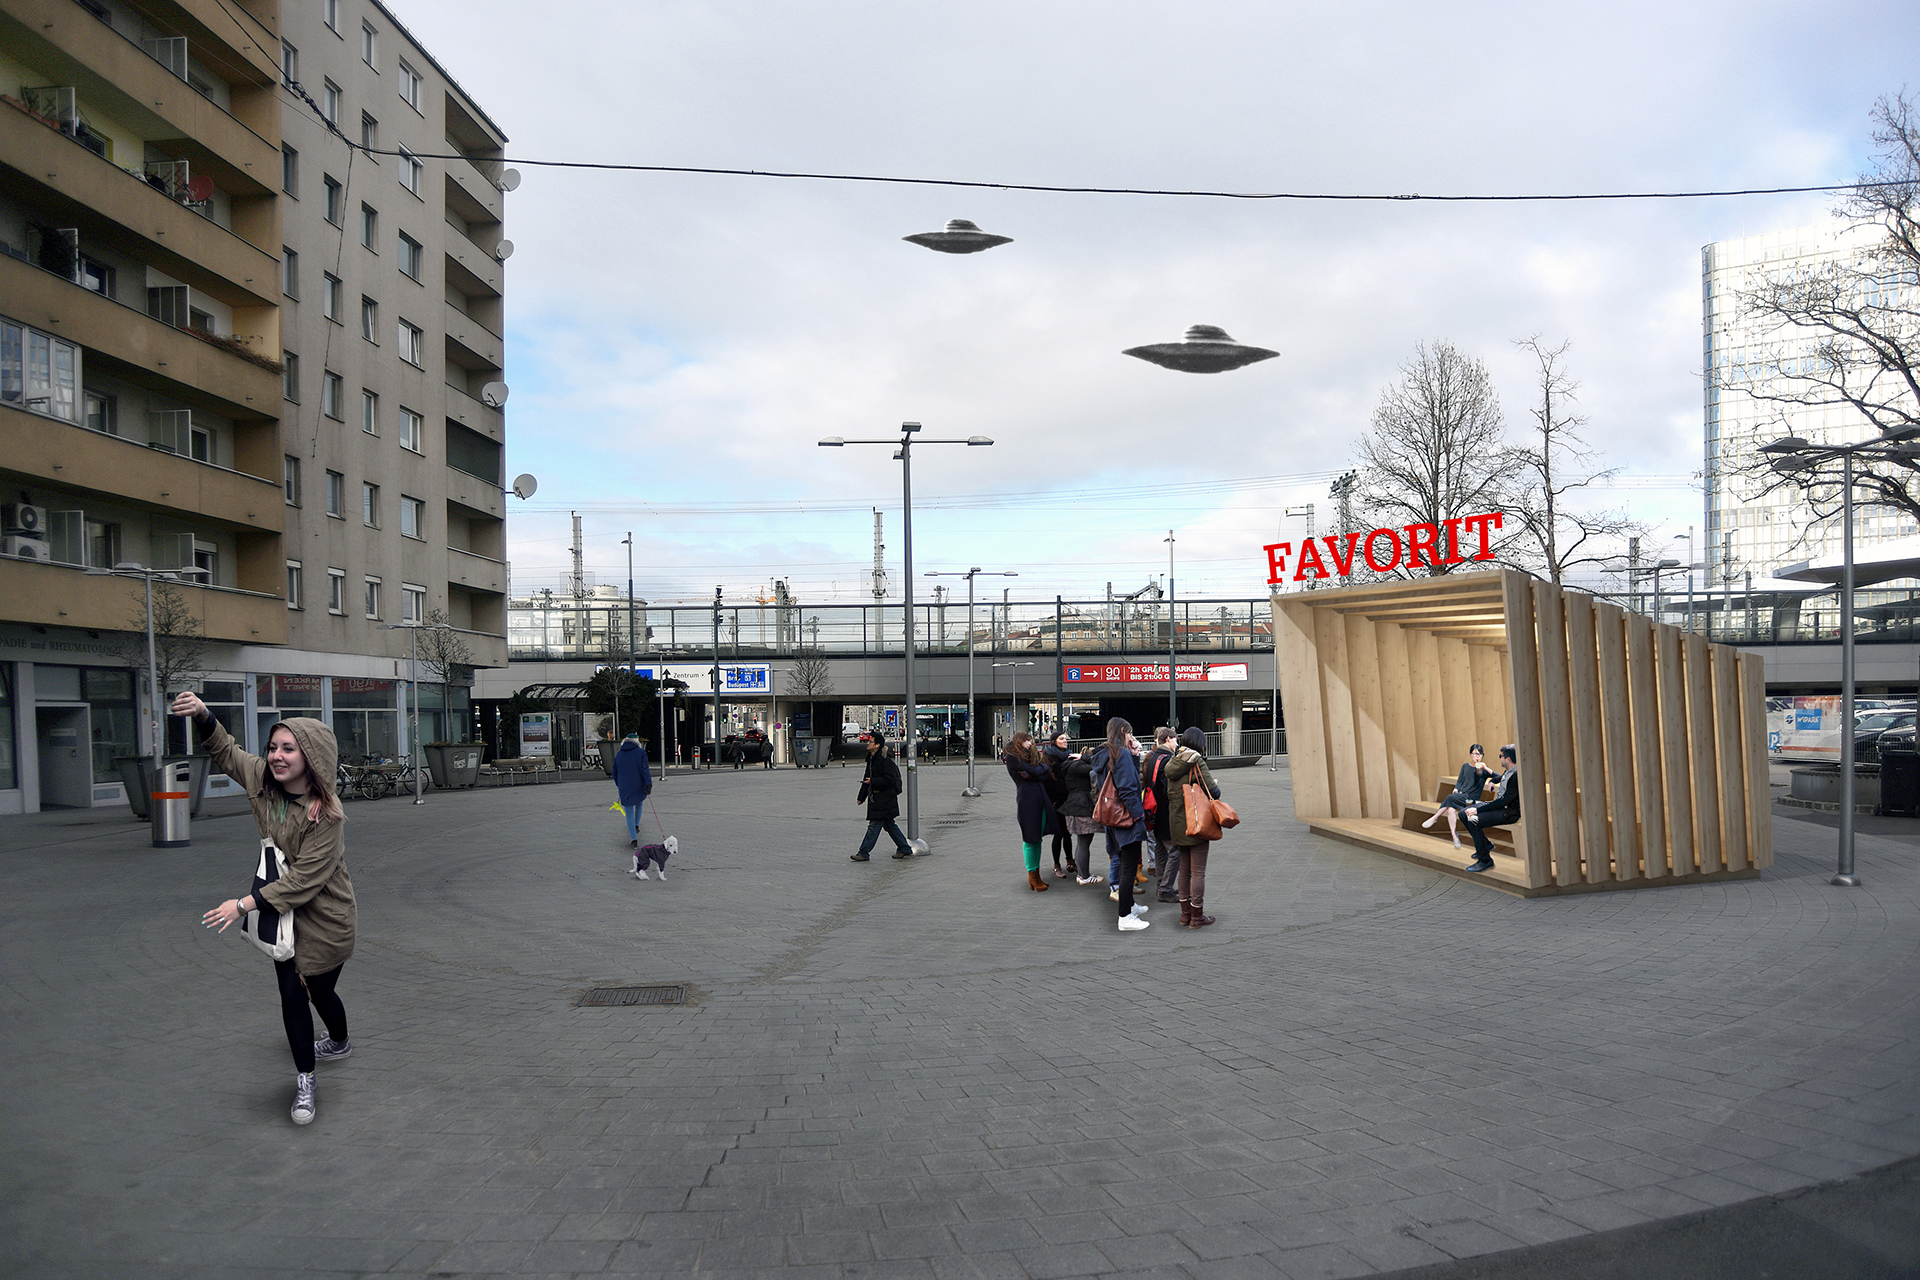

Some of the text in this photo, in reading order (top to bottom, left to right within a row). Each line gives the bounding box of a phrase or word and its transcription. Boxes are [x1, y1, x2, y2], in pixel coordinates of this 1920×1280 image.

[1263, 512, 1502, 584] FAVORIT
[1105, 667, 1120, 677] 90
[1771, 734, 1778, 748] P
